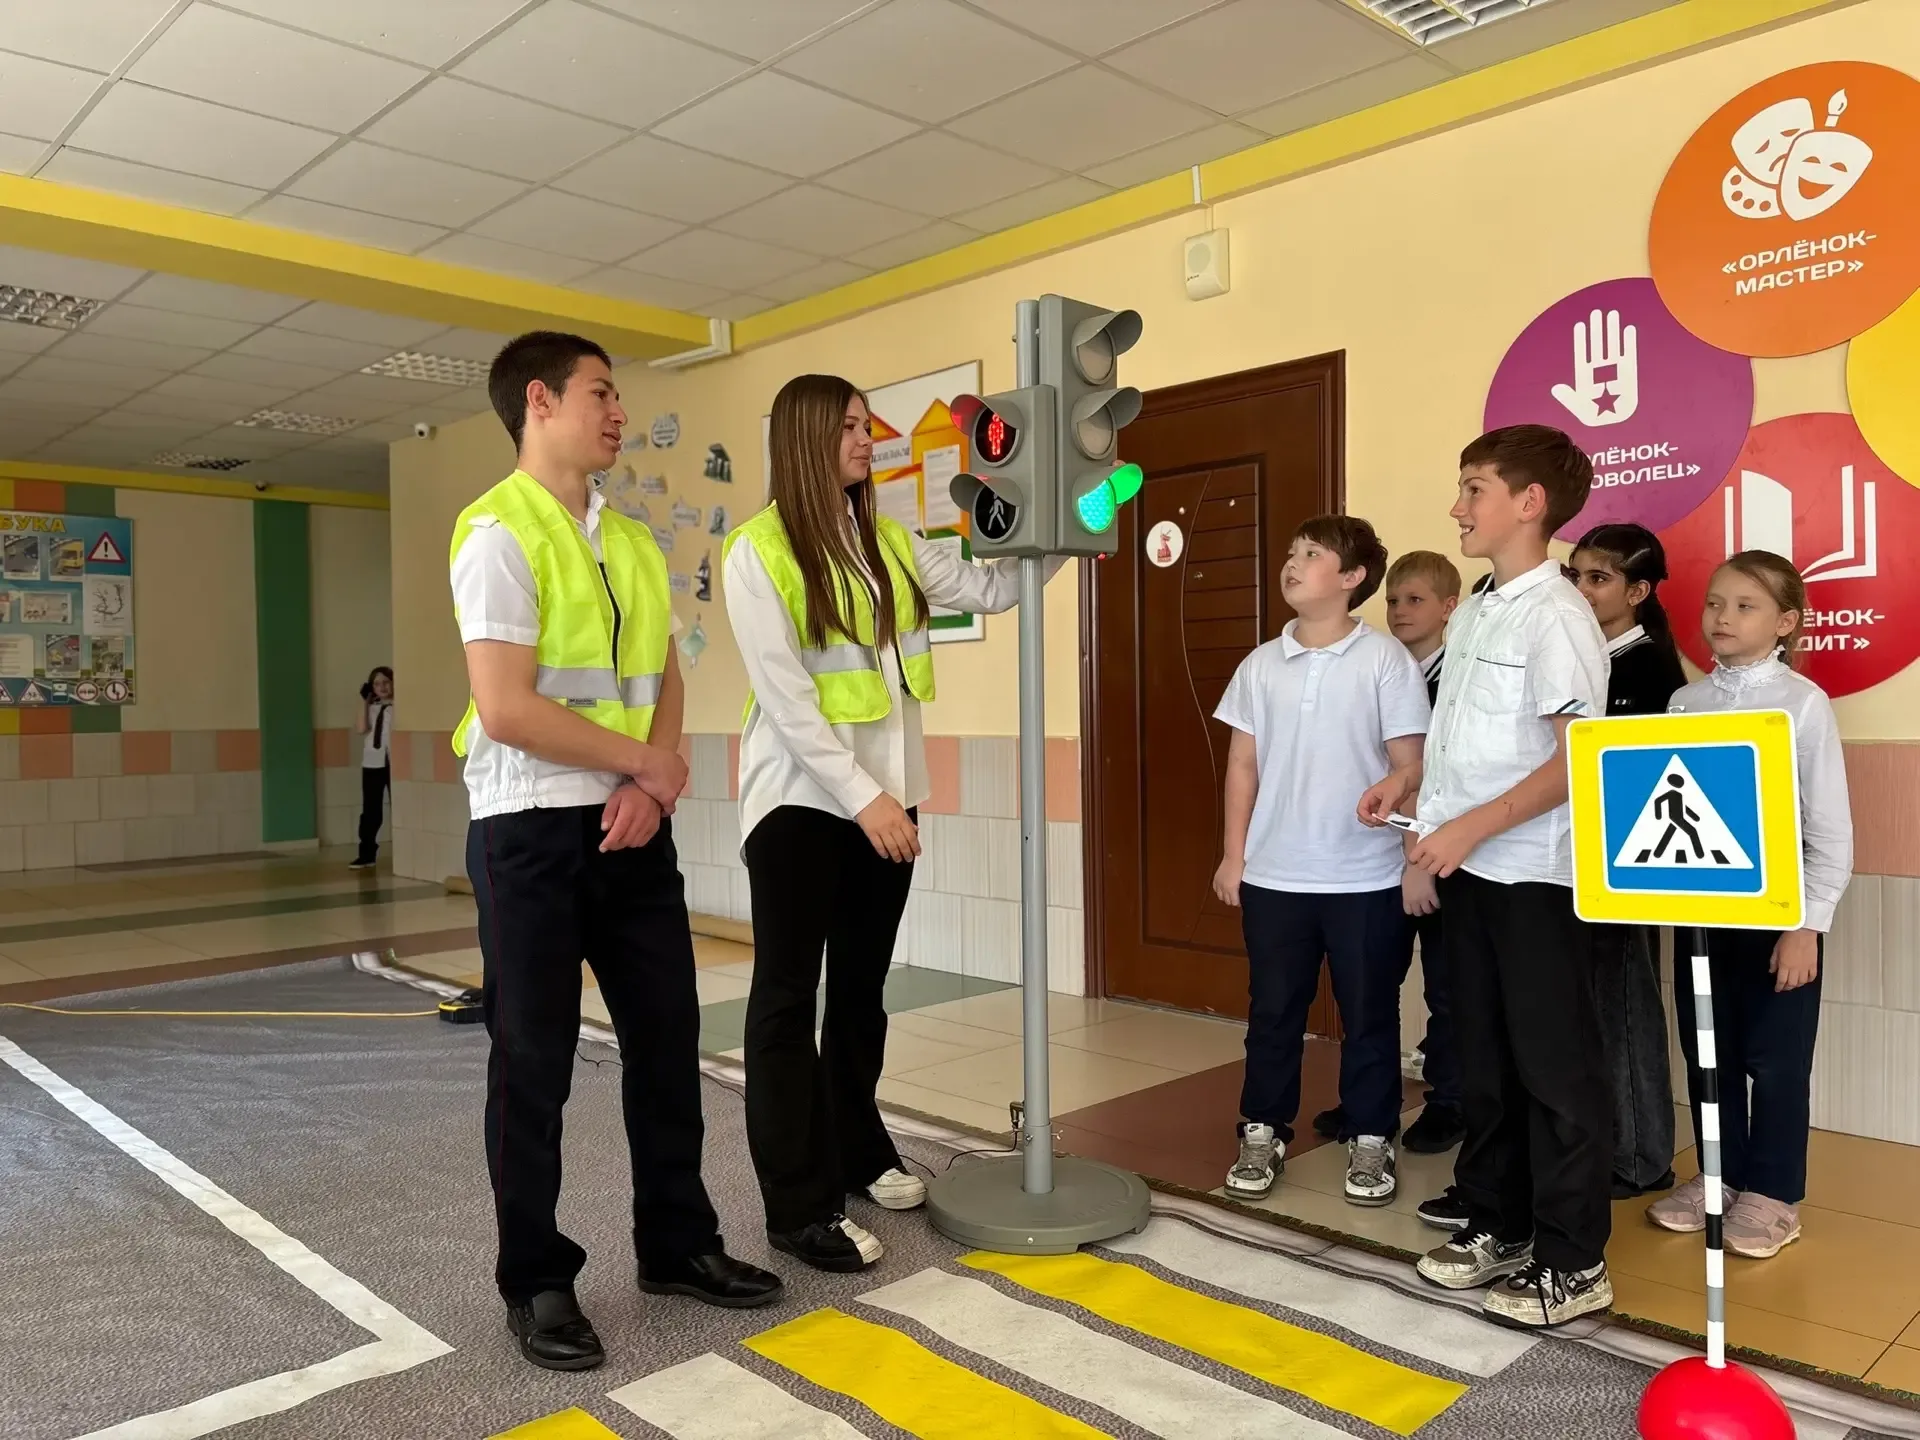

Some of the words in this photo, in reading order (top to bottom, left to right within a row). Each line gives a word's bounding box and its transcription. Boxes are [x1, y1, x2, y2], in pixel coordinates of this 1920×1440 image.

[1721, 230, 1877, 275] «ОРЛЁНОК-
[1735, 259, 1864, 296] МАСТЕР»
[1586, 441, 1679, 468] ЛЁНОК-
